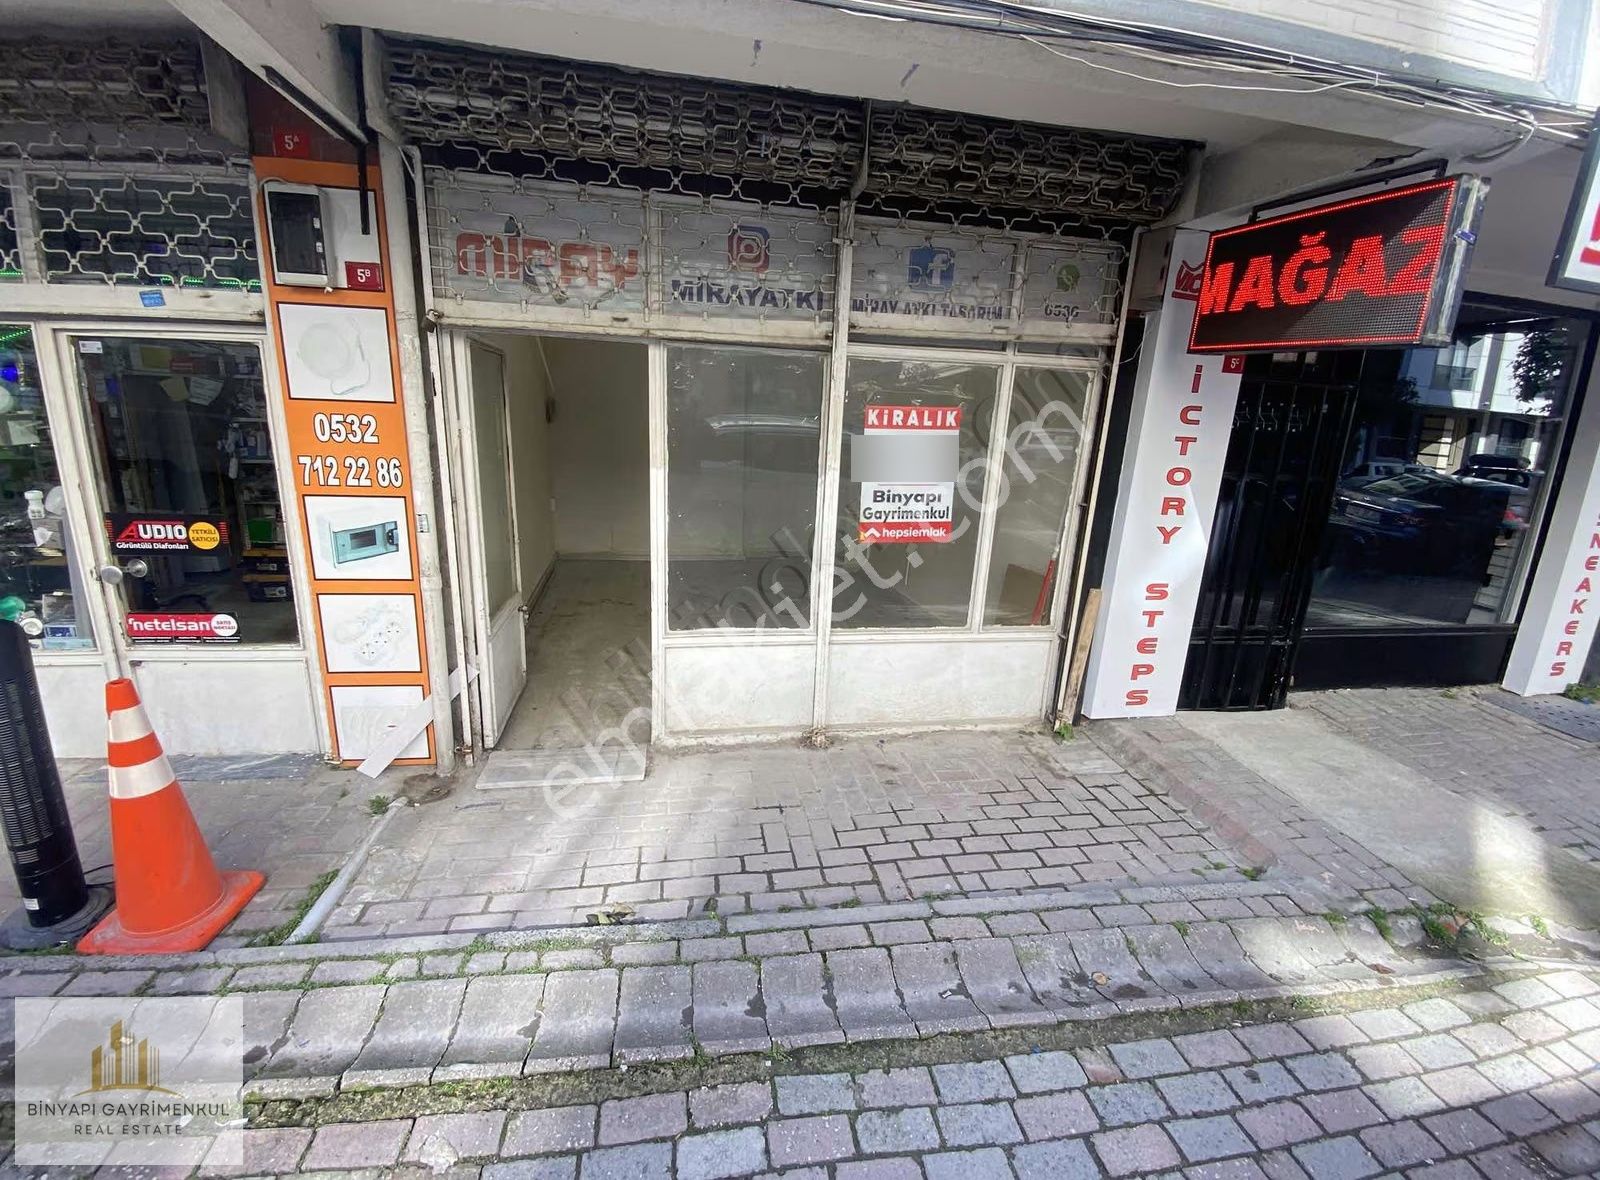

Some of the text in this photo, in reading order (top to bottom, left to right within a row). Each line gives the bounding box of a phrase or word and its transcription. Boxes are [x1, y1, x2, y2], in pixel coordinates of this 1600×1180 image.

[313, 412, 379, 444] 0532
[297, 454, 403, 488] 712 22 86
[872, 490, 942, 506] Binyapı
[862, 506, 949, 523] Gayrimenkul
[116, 520, 188, 541] AUDIO
[882, 527, 946, 539] hepsiemlak
[1549, 513, 1600, 677] NEAKERS
[128, 617, 211, 631] netelsan
[1125, 583, 1169, 706] STEPS
